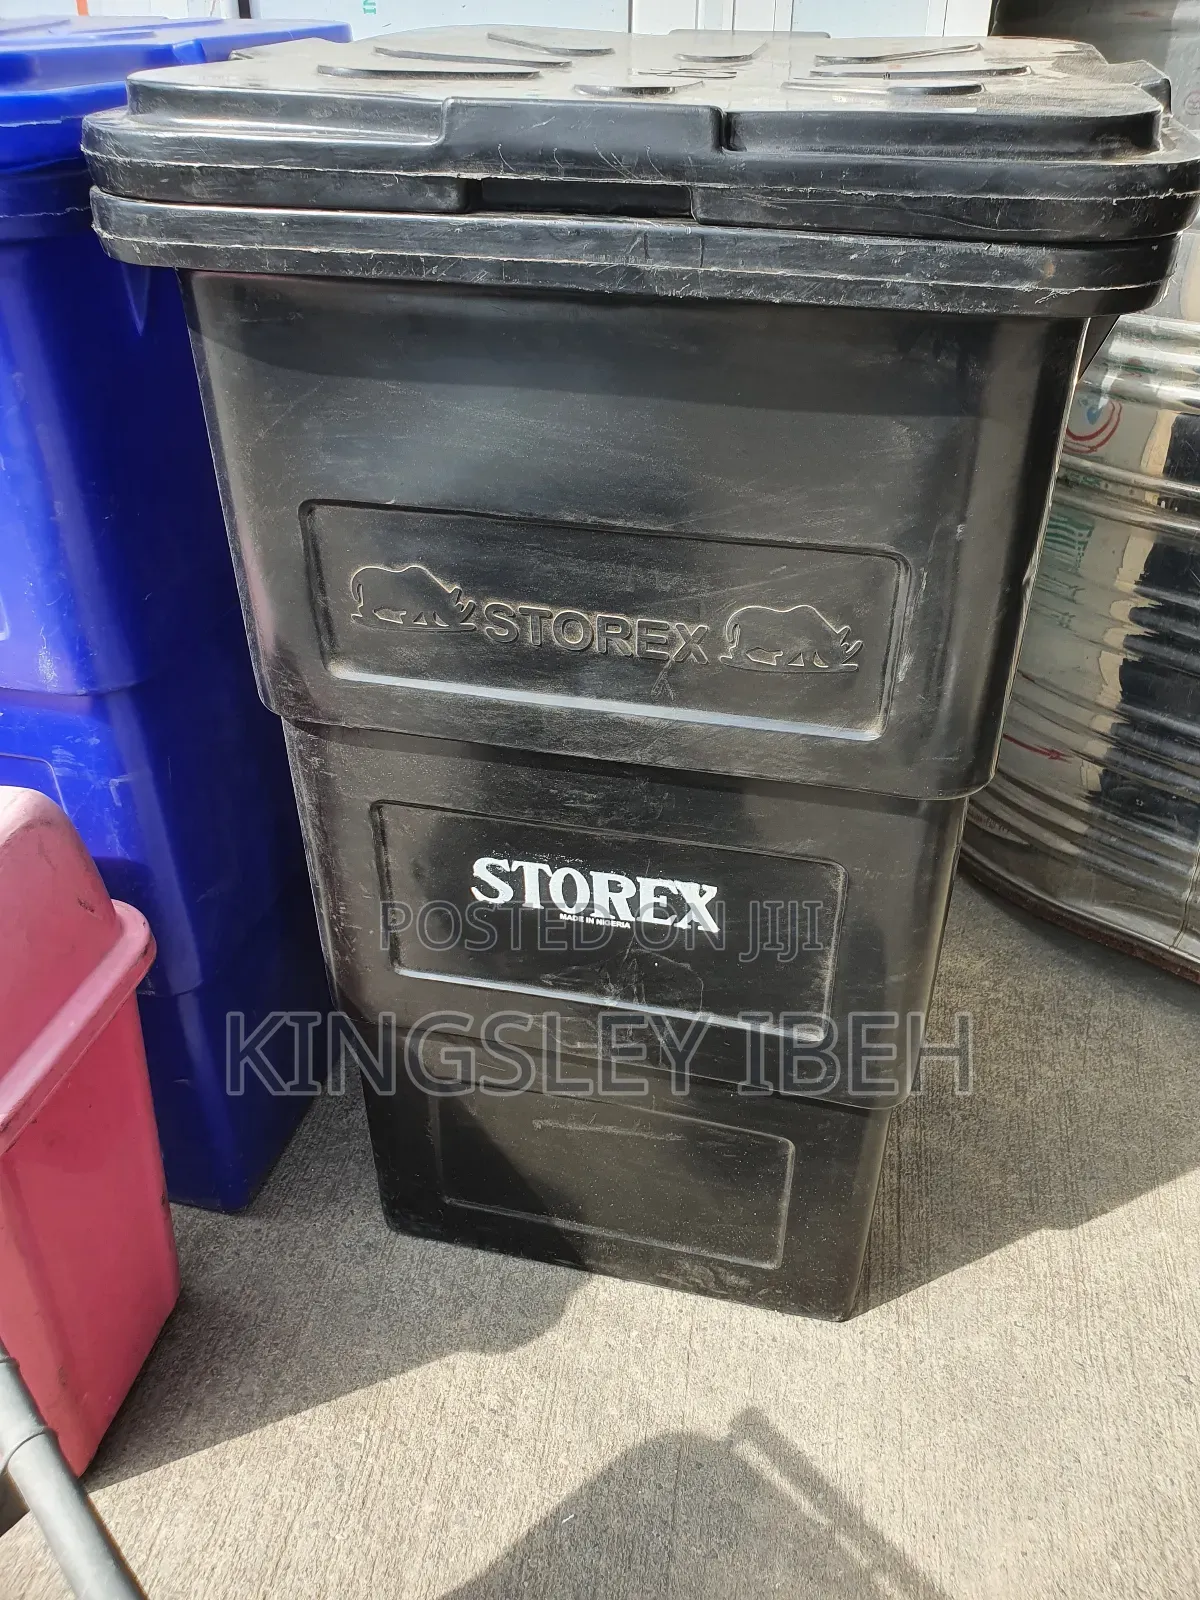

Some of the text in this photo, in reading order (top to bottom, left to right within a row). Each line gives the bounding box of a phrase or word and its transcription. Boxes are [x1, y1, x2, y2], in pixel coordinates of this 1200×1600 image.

[483, 601, 710, 665] STOREX
[470, 857, 720, 933] STOREX
[559, 913, 631, 929] MADE IN NIGERIA
